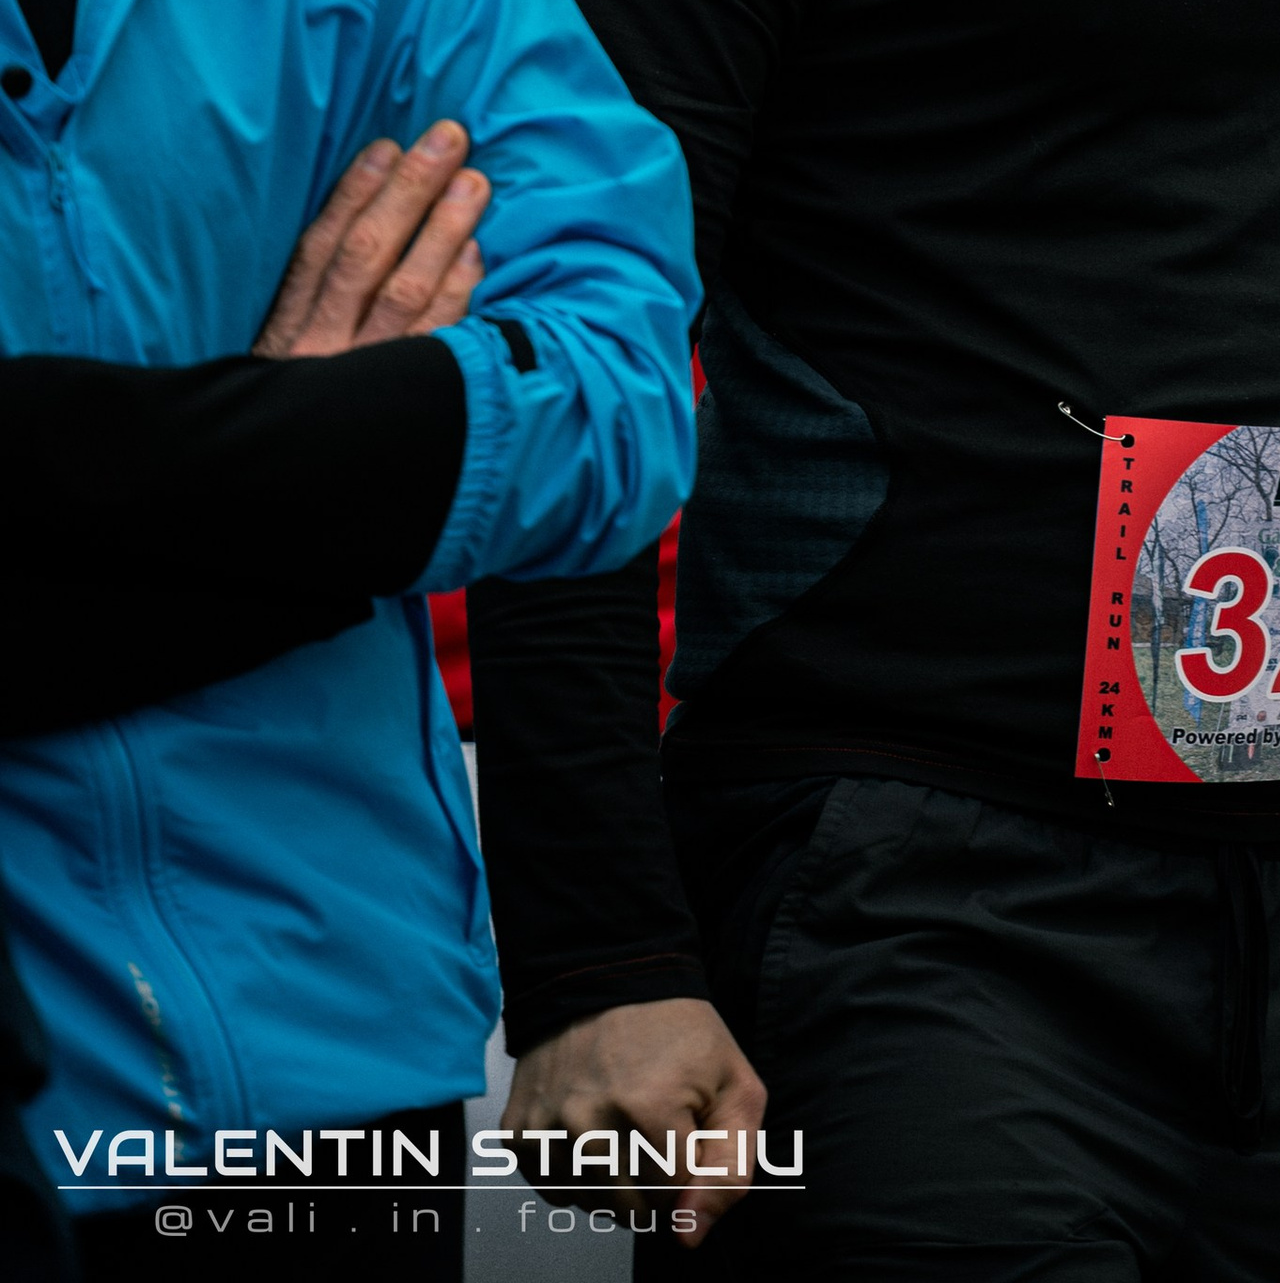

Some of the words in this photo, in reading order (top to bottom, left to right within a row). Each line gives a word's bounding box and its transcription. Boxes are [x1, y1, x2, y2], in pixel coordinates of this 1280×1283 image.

[1115, 458, 1135, 560] TRAIL
[1107, 592, 1124, 650] RUN
[1172, 728, 1258, 745] Powered
